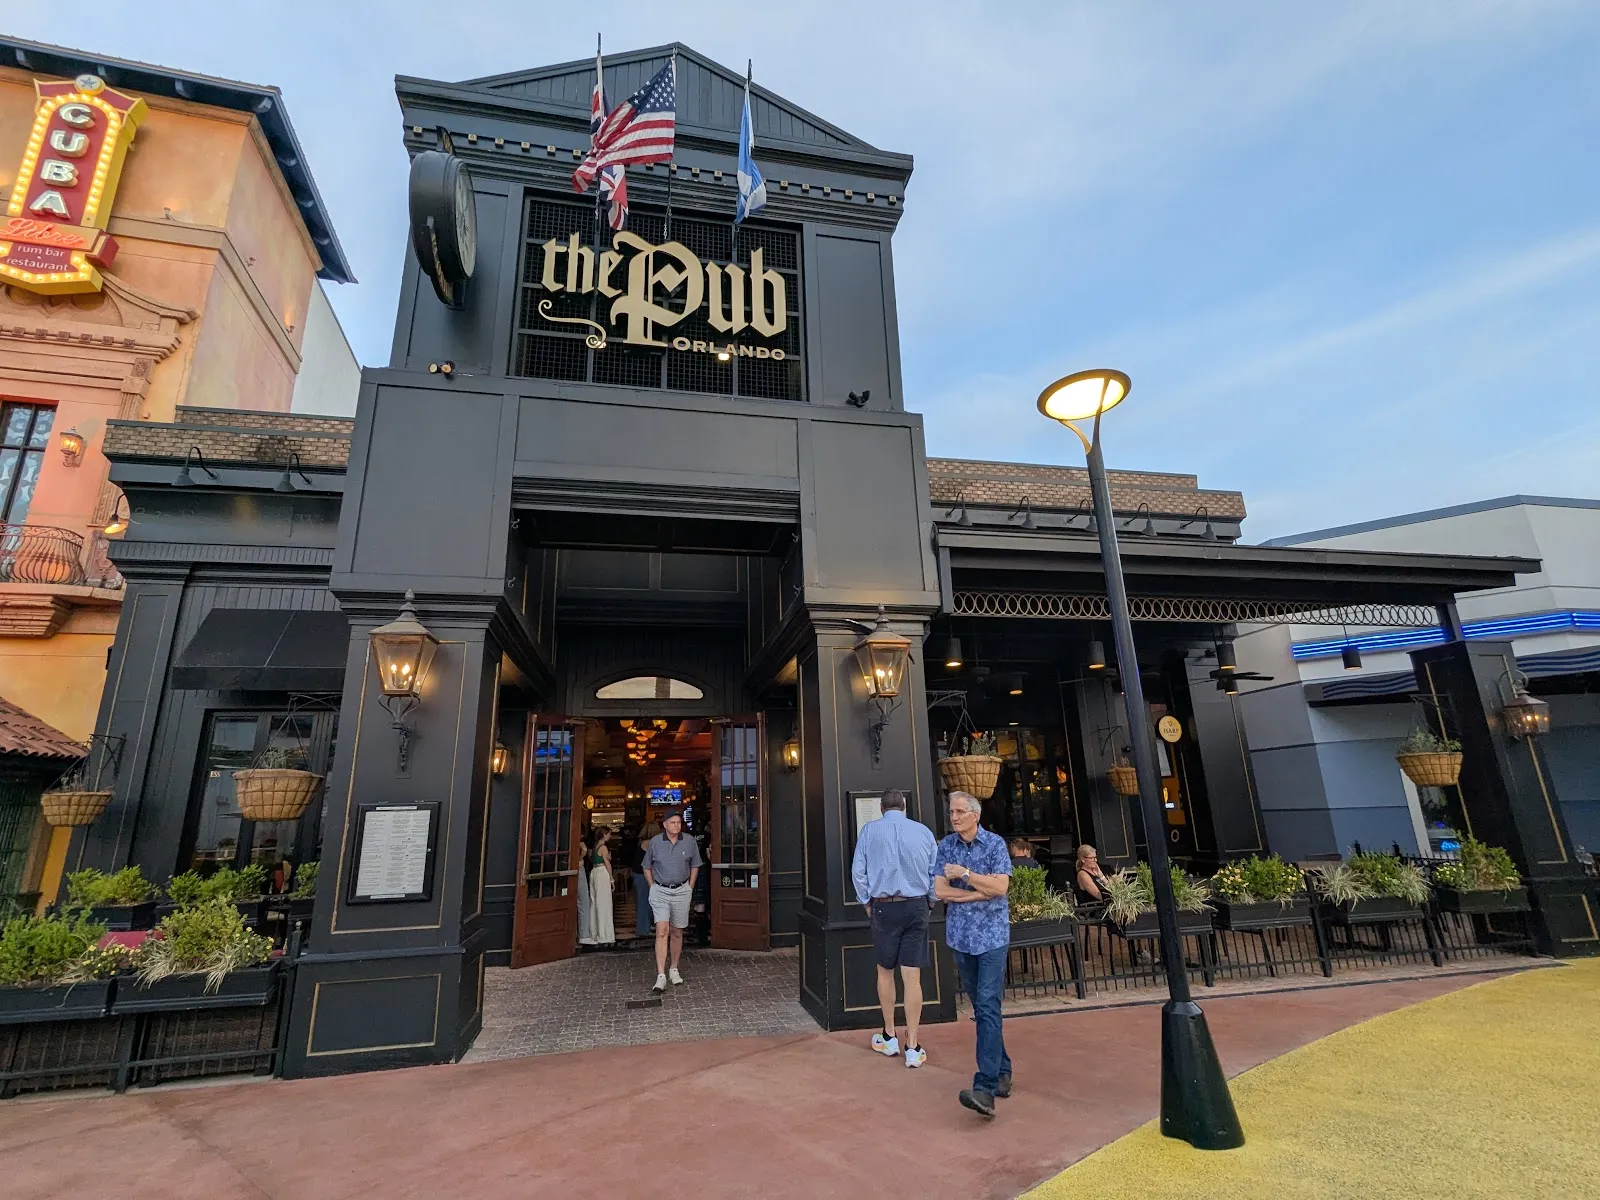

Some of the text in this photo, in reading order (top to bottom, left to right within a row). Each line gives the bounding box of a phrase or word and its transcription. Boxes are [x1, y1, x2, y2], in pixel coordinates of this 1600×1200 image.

[29, 103, 97, 220] CUBA
[0, 217, 85, 245] Libre
[6, 257, 69, 271] restaurant
[17, 245, 66, 257] rum bar
[541, 230, 787, 347] the Pub
[672, 336, 786, 361] ORLANDO
